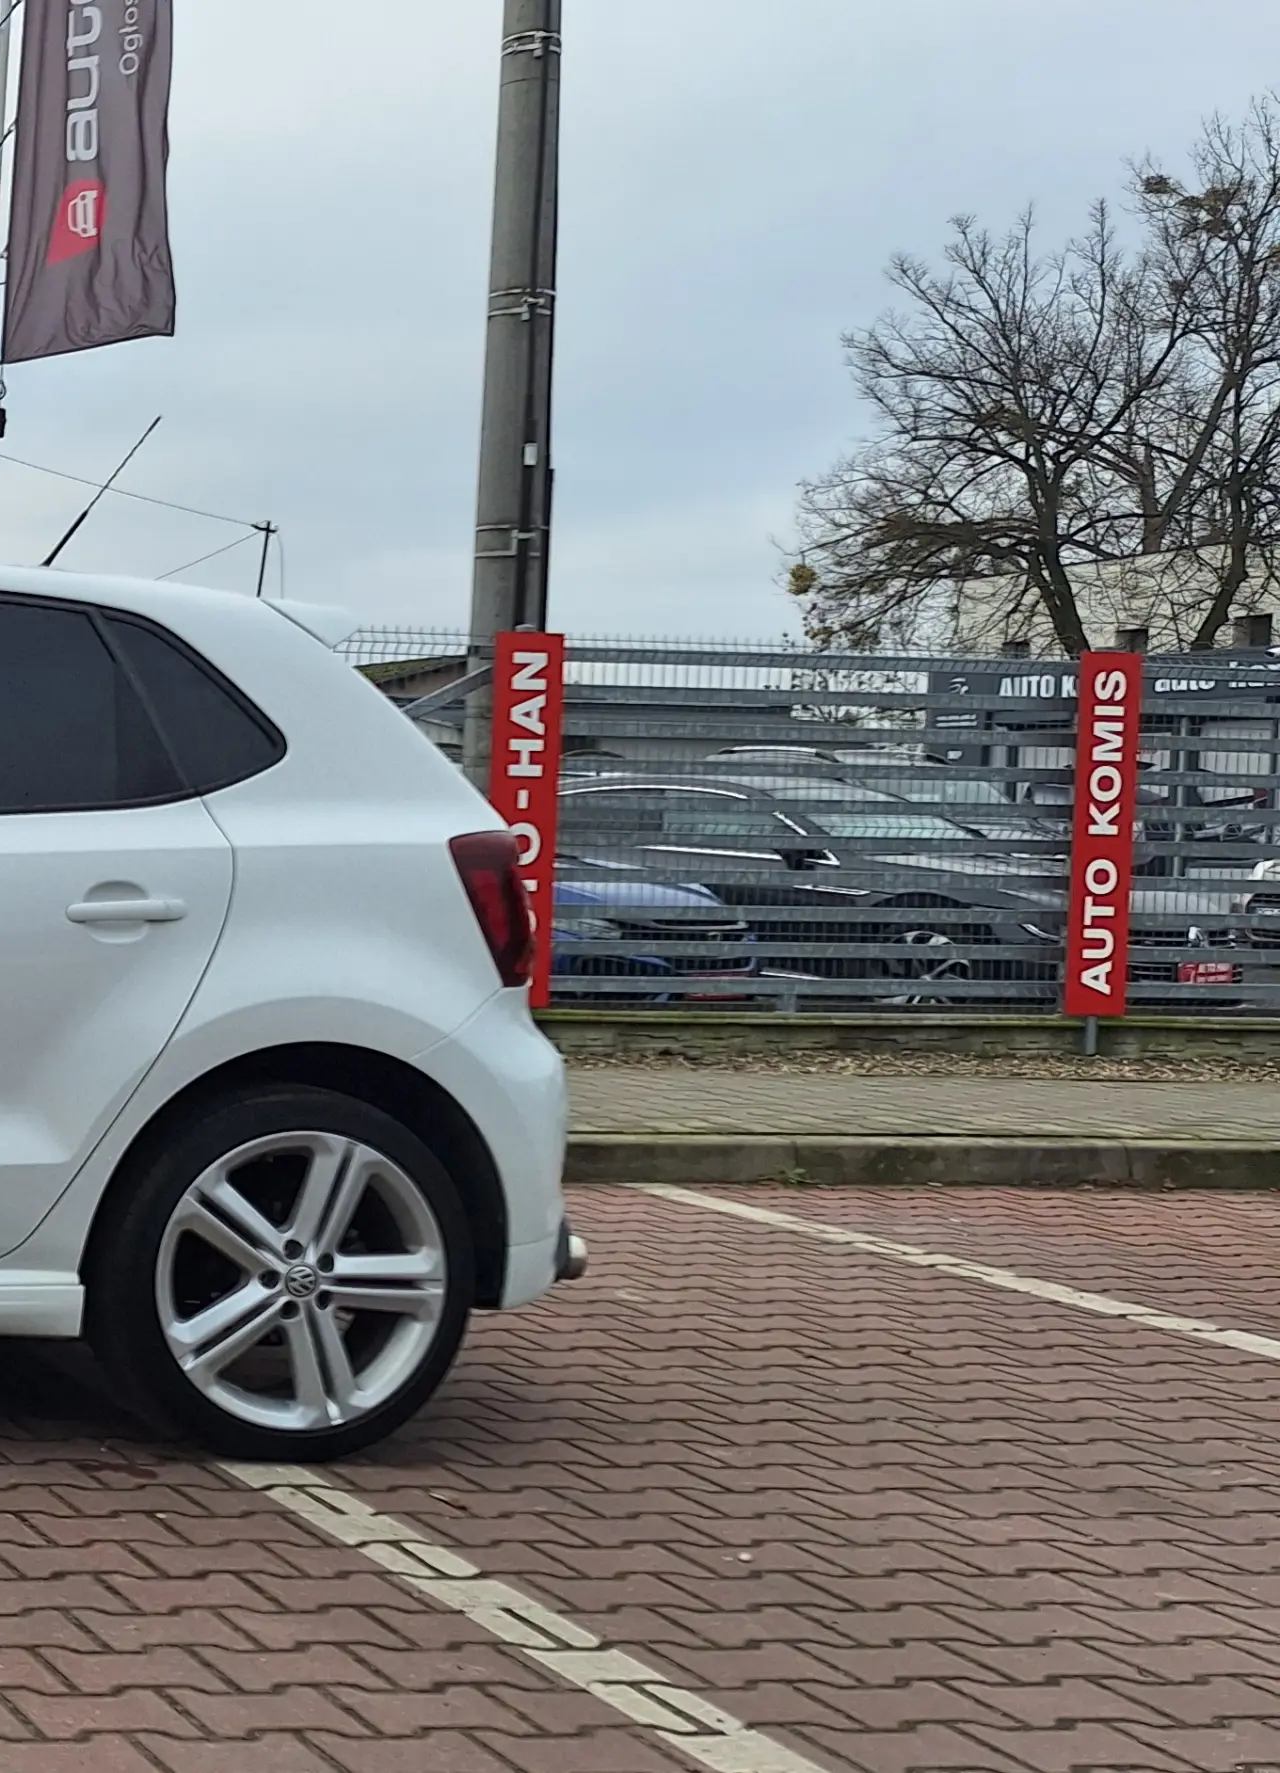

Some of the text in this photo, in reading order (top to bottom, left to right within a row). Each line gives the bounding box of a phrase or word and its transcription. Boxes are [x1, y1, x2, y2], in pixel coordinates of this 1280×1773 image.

[66, 0, 103, 161] aut
[998, 674, 1056, 698] AUTO
[507, 651, 549, 988] O-HAN
[1080, 670, 1127, 996] AUTO KOMIS
